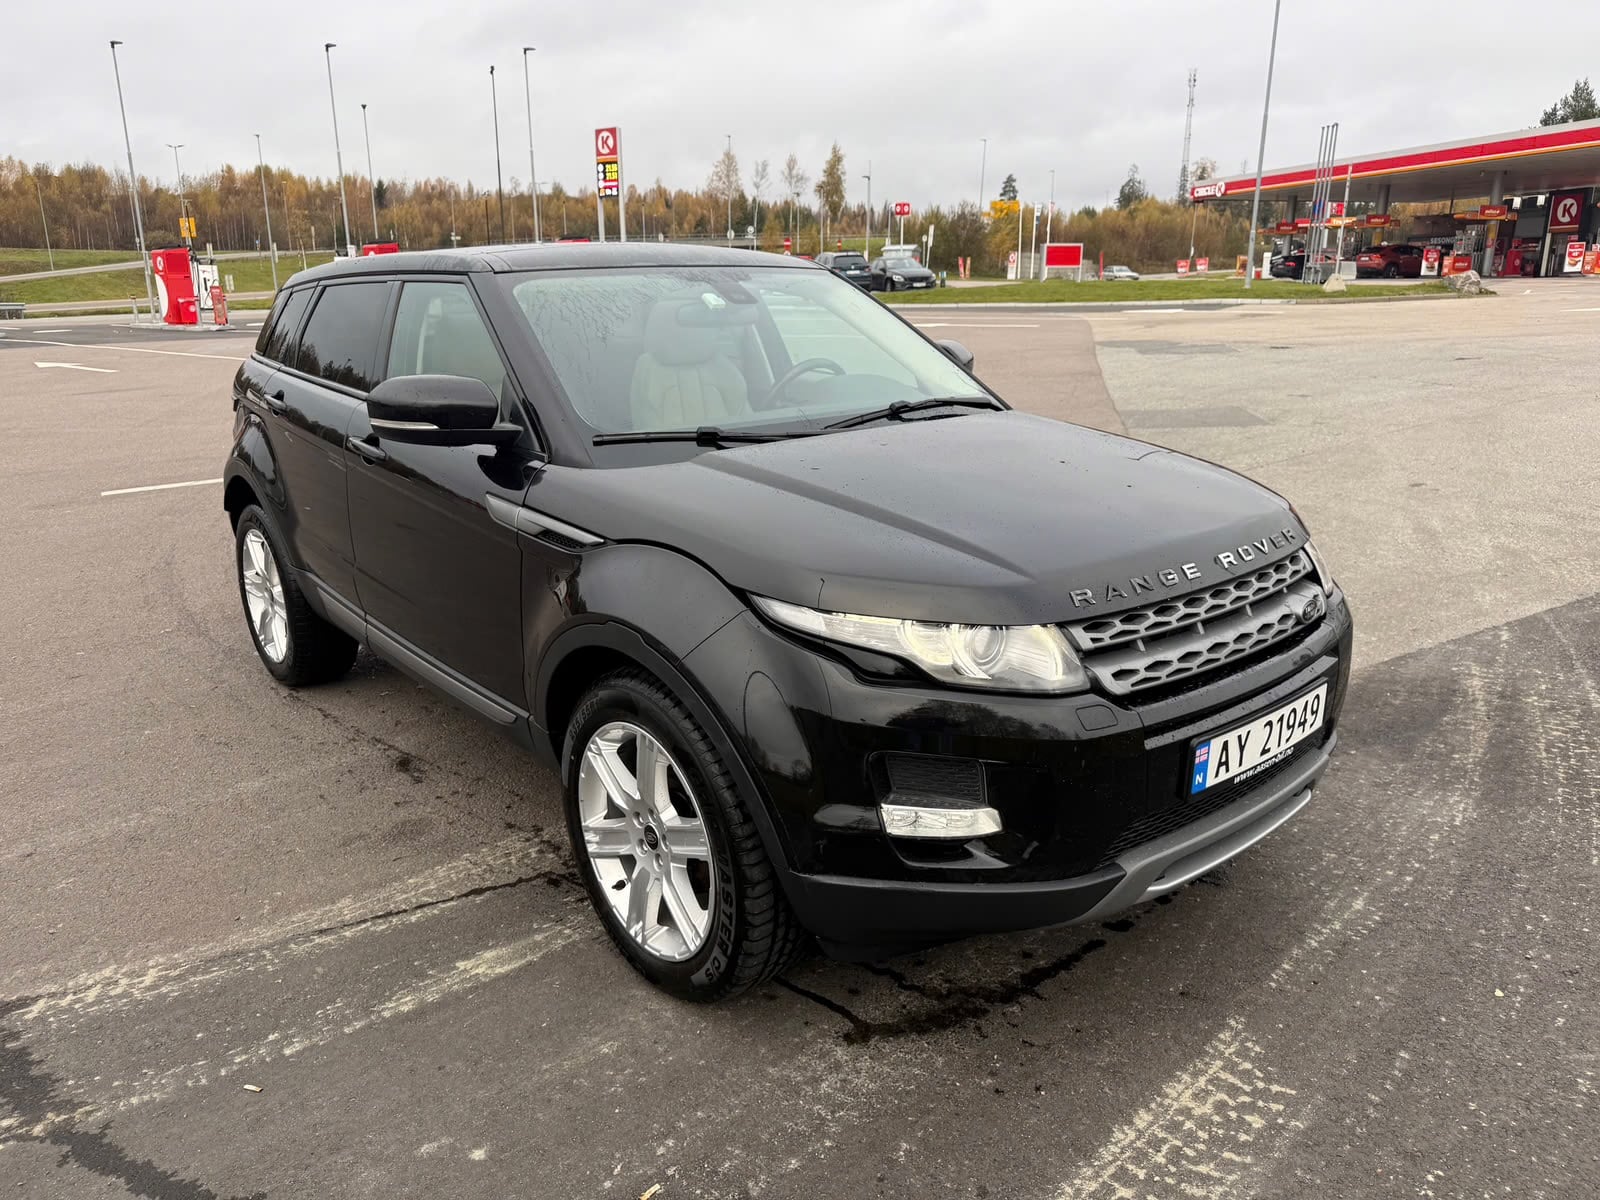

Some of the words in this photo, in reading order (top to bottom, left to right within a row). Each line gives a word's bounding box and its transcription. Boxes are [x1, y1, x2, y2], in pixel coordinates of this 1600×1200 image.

[600, 133, 613, 153] K
[1194, 185, 1216, 197] CIRCLE
[1216, 182, 1225, 197] K
[1559, 200, 1576, 222] K
[1068, 562, 1201, 607] RANGE
[1216, 527, 1296, 568] ROVER
[1214, 729, 1251, 779] AY
[1260, 693, 1320, 757] 21949
[1195, 772, 1204, 785] N
